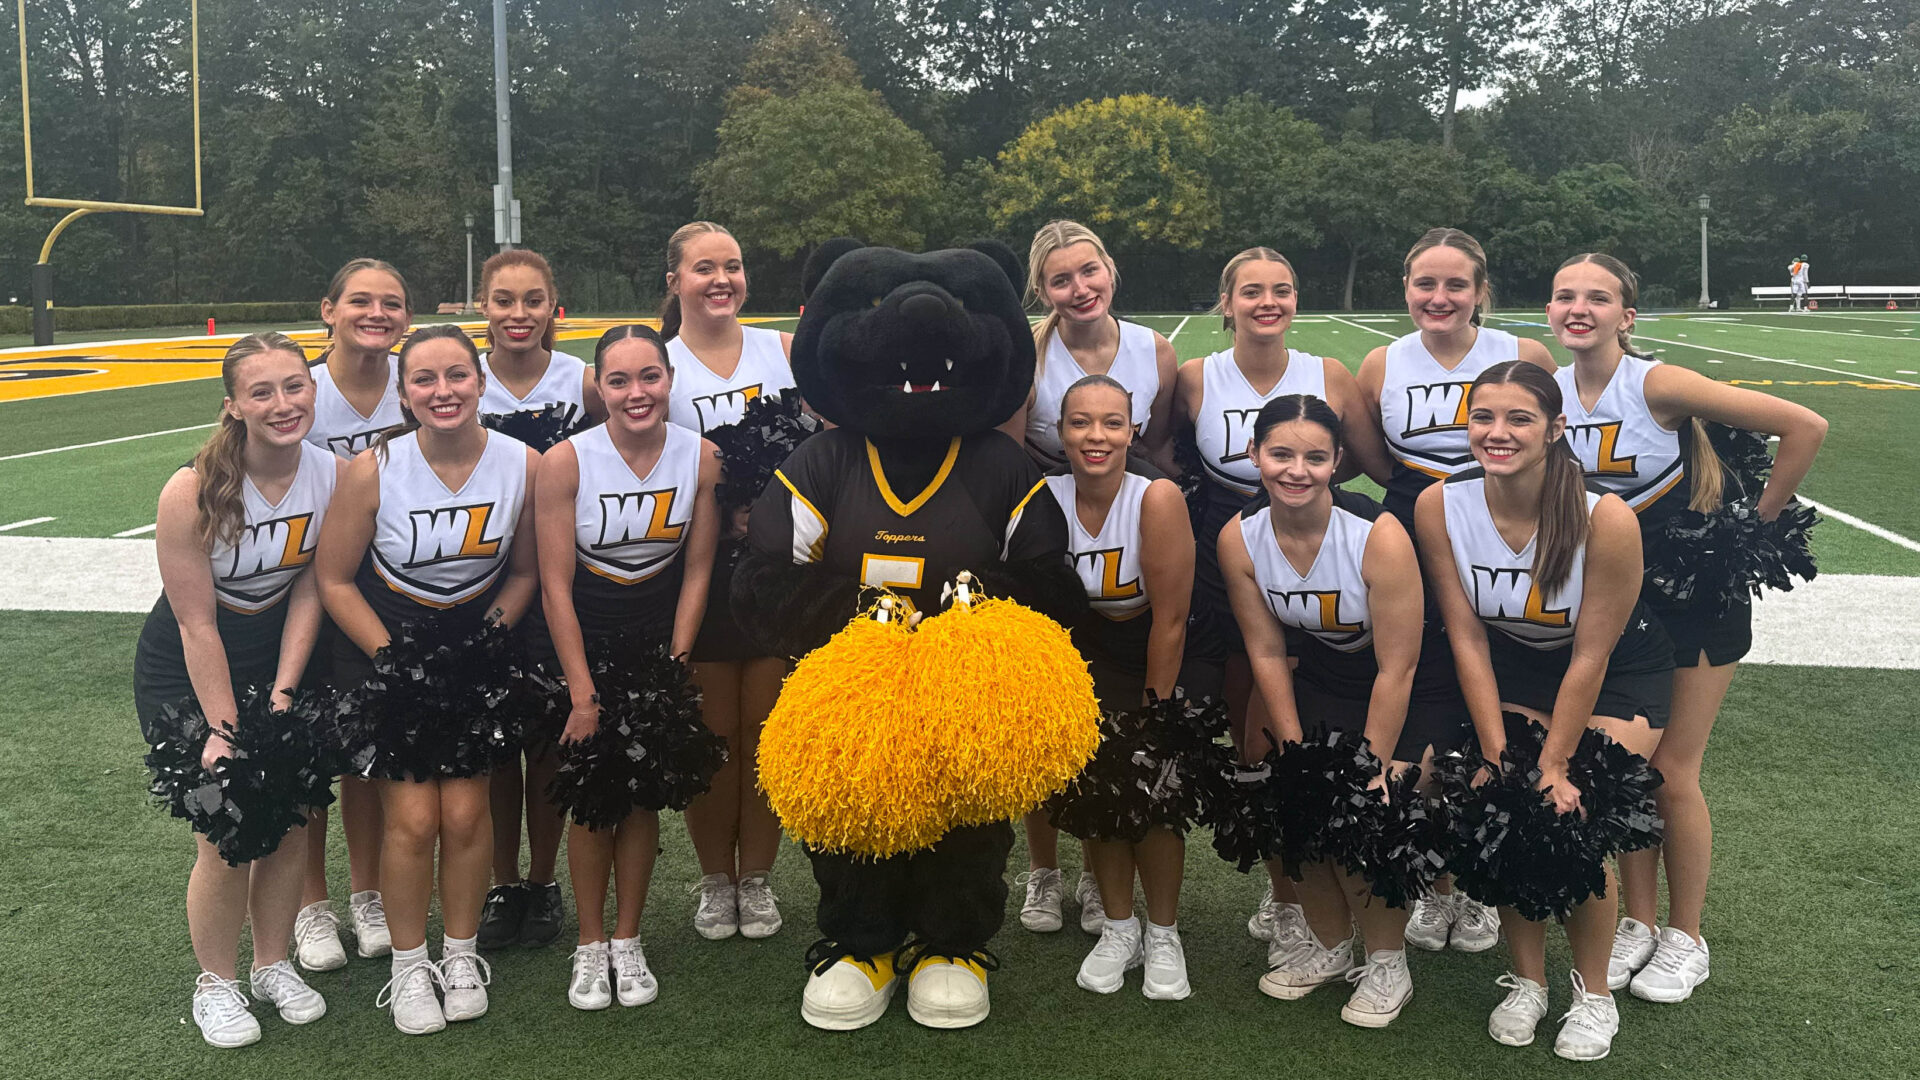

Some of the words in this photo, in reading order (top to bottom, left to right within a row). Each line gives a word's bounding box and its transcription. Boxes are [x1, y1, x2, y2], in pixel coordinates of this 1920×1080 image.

[1565, 420, 1638, 477] WL
[221, 512, 318, 582] WL
[402, 502, 503, 569] WL
[590, 487, 691, 550] WL
[875, 531, 926, 544] Toppers
[1064, 547, 1143, 601] WL
[1471, 565, 1571, 627] WL
[1267, 590, 1364, 634] WL
